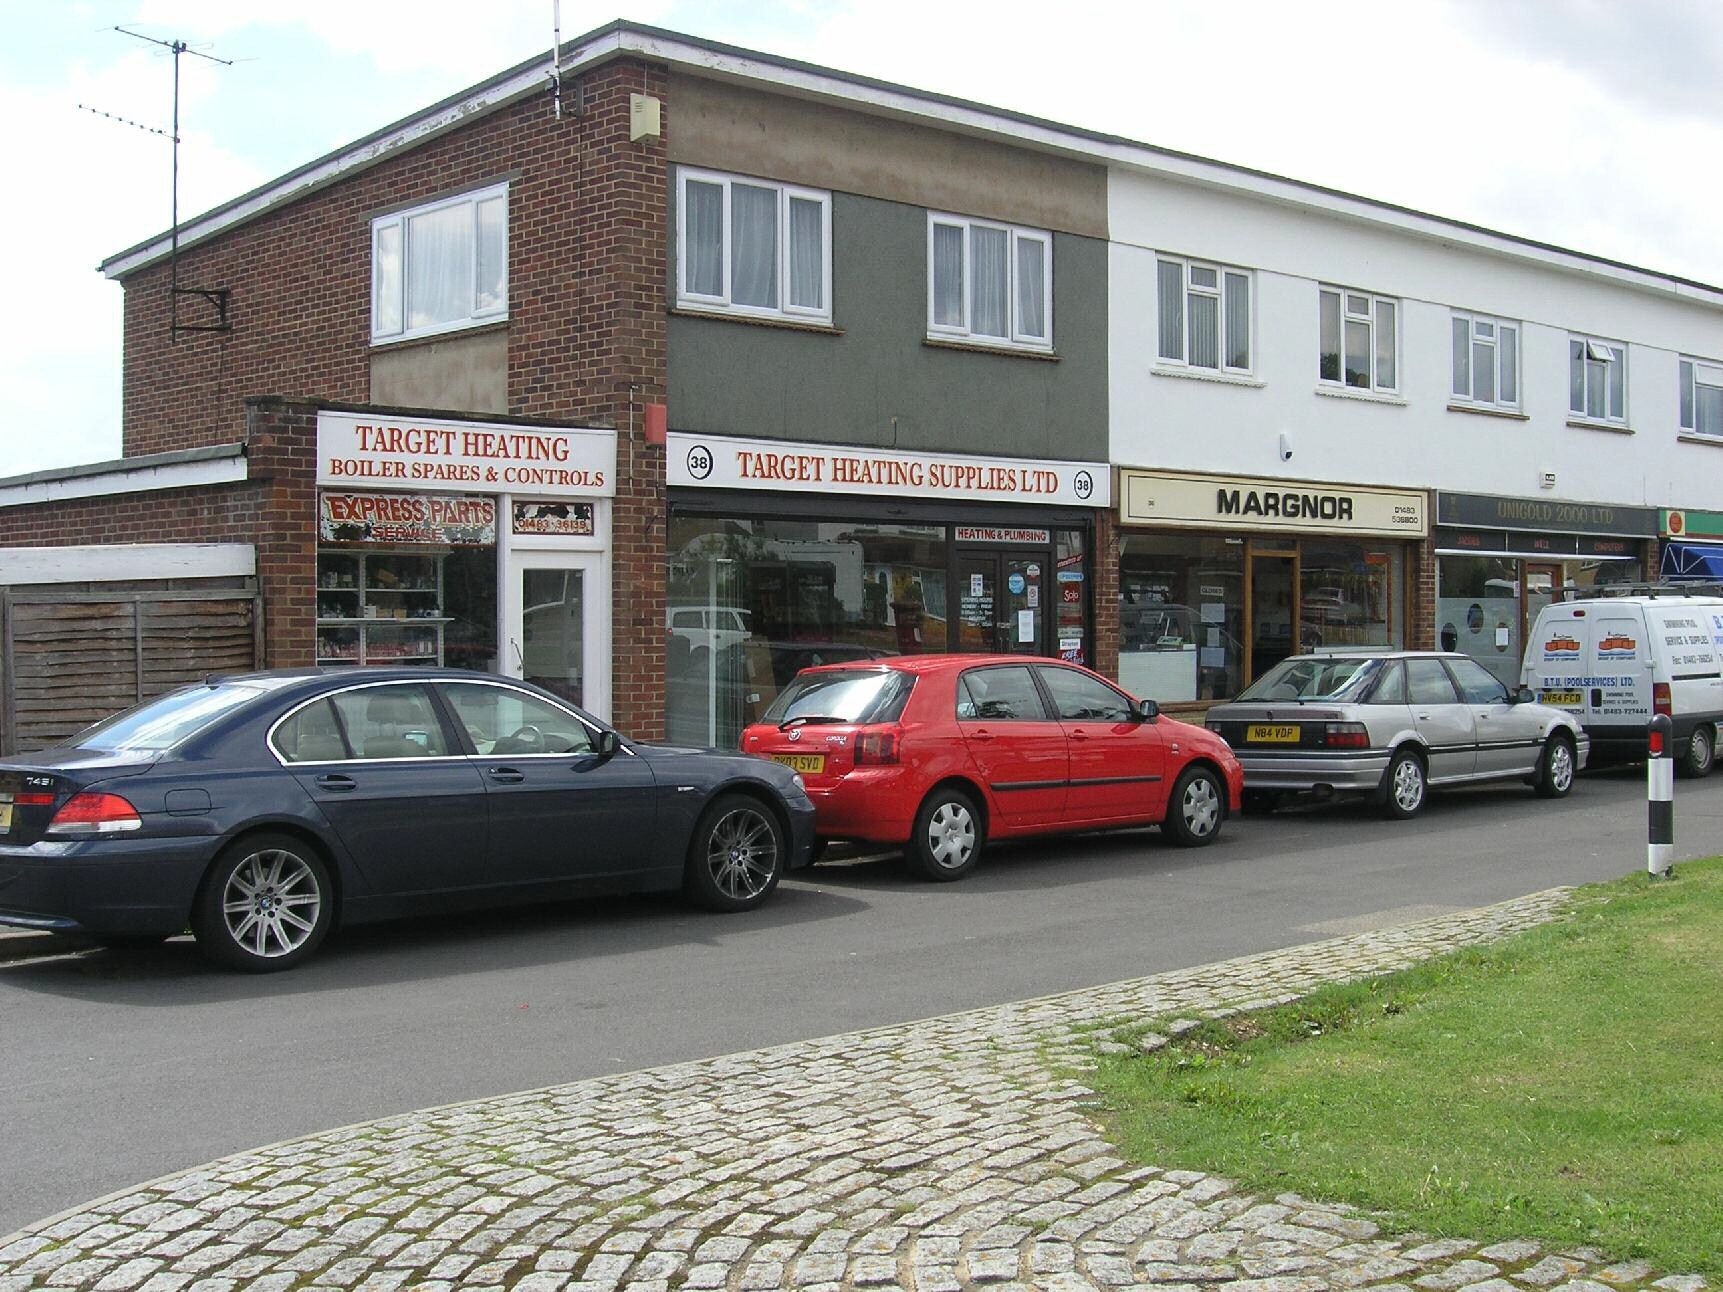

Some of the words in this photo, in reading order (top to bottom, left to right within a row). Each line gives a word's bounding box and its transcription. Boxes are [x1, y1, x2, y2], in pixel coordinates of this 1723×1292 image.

[356, 425, 456, 456] TARGET
[462, 431, 570, 462] HEATING
[330, 458, 407, 478] BOILER
[411, 461, 480, 482] SPARES
[486, 466, 498, 483] &
[504, 467, 604, 487] CONTROLS
[690, 456, 707, 468] 38
[737, 451, 825, 481] TARGET
[832, 457, 924, 487] HEATING
[929, 464, 1017, 491] SUPPLIES
[1020, 469, 1058, 494] LTD
[1077, 479, 1090, 492] 38
[325, 495, 425, 523] EXPRESS
[427, 500, 494, 525] PARTS
[1216, 488, 1352, 520] MARGNOR
[1498, 501, 1551, 521] UNIGOLD
[1556, 504, 1588, 523] 2000
[1592, 508, 1613, 524] LTD
[373, 526, 444, 540] SERVICE
[518, 519, 549, 529] 01483
[958, 528, 995, 540] HEATING
[997, 530, 1004, 539] &
[1004, 530, 1047, 541] PLUMBING
[1064, 589, 1079, 602] Solo
[1543, 677, 1562, 687] B.T.U.
[1564, 676, 1618, 688] (POOLSERVICES)
[1620, 677, 1635, 687] LTD.
[1254, 728, 1272, 738] N84
